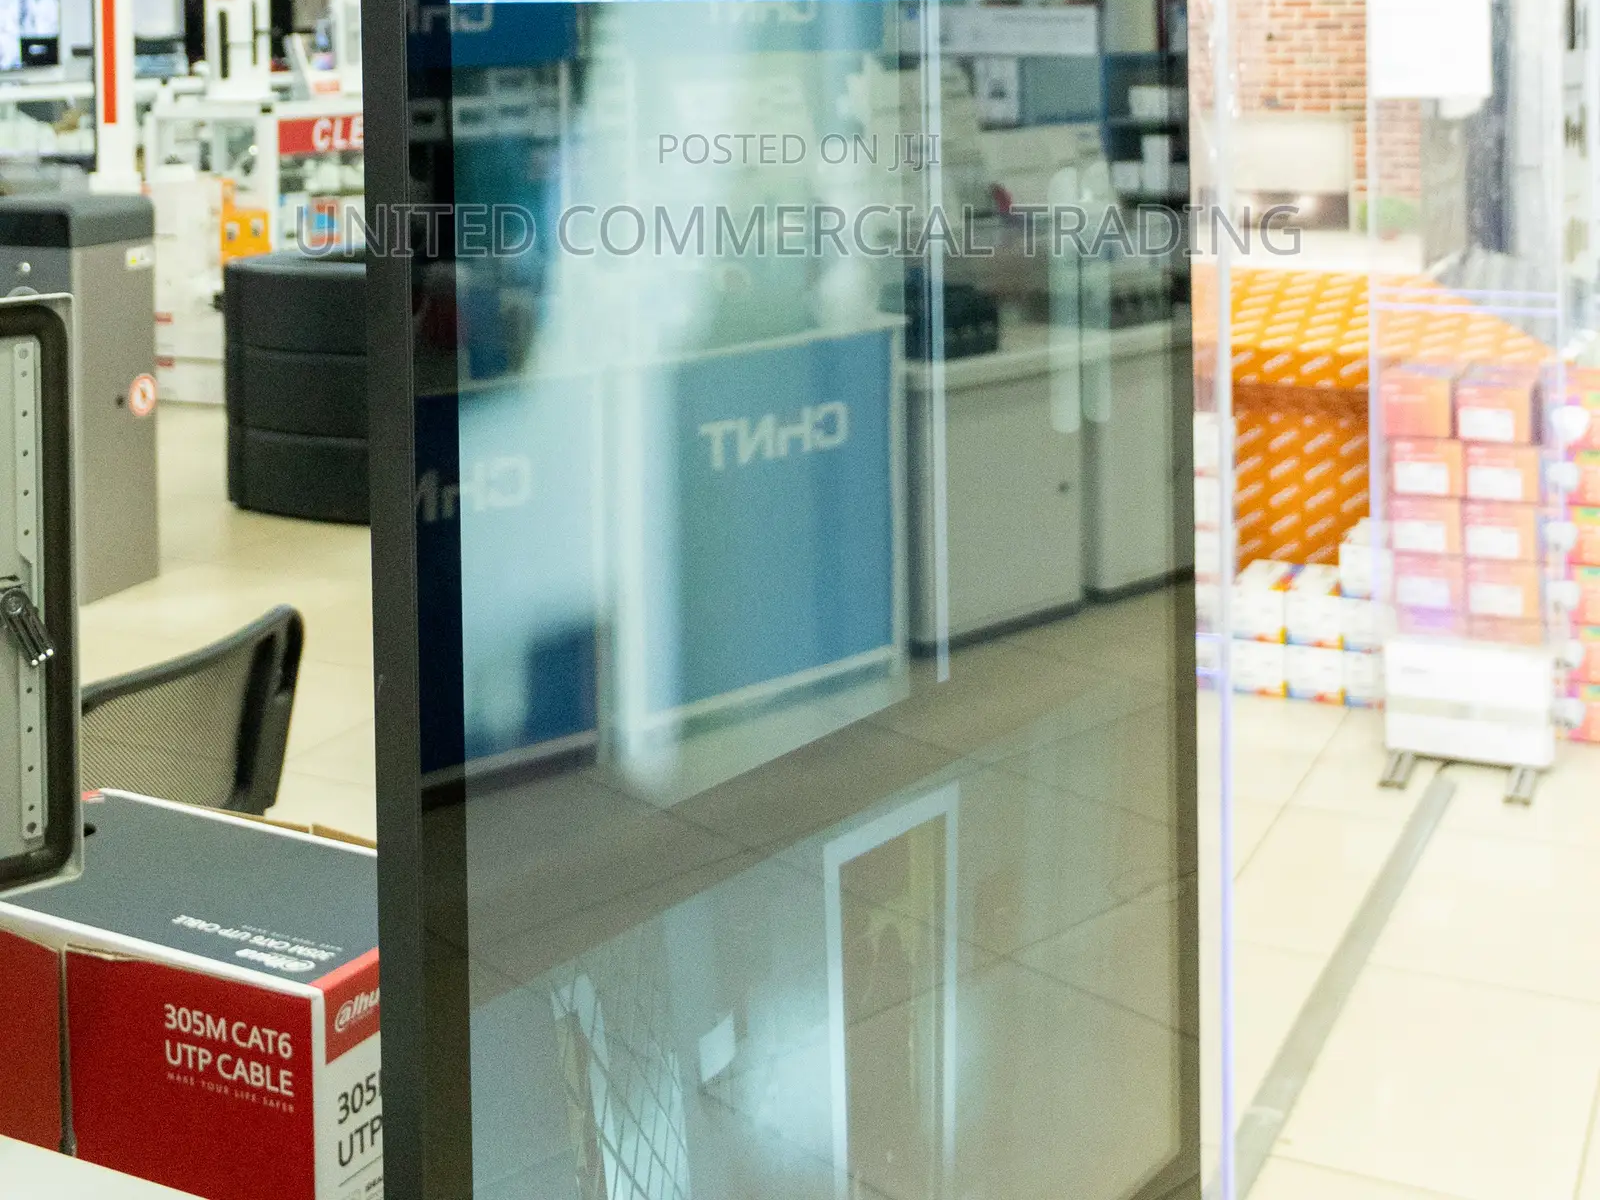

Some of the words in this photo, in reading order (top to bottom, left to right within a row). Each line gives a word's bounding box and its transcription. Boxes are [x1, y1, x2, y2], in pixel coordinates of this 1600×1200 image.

[312, 116, 364, 152] CLE
[163, 1003, 227, 1042] 305M
[231, 1020, 293, 1060] CAT6
[165, 1039, 213, 1073] UTP
[216, 1052, 295, 1098] CABLE
[337, 1068, 382, 1125] 305
[338, 1113, 383, 1168] UTP
